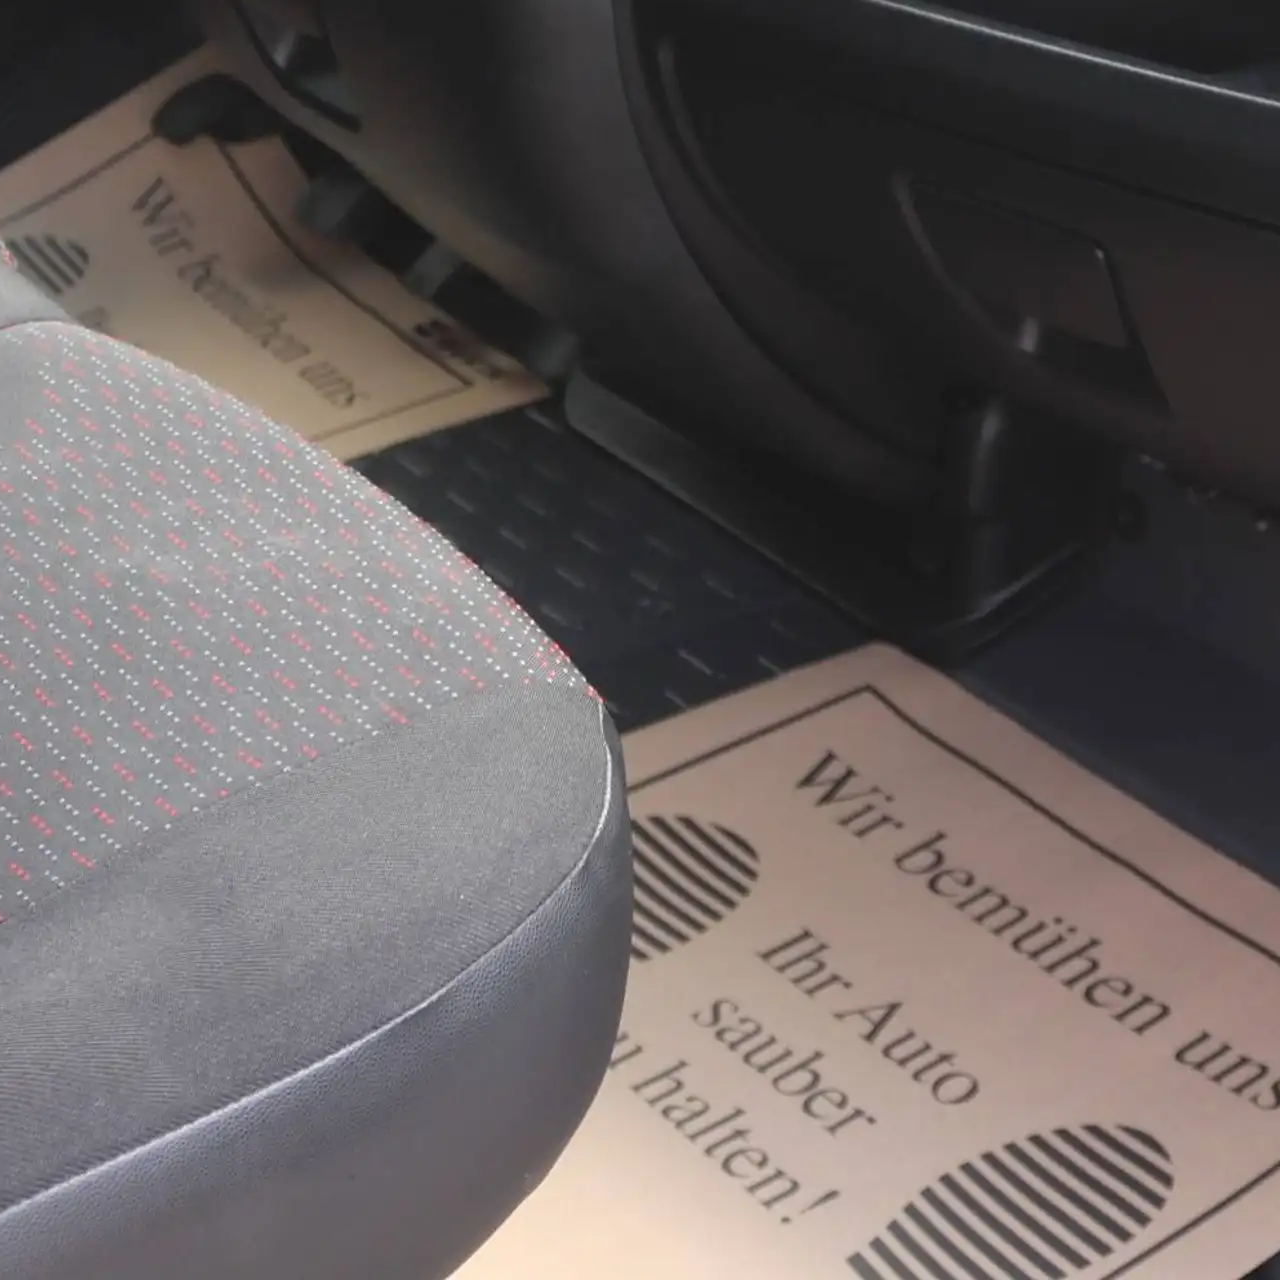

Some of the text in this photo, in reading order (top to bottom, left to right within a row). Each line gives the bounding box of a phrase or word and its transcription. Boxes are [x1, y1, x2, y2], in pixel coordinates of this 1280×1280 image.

[794, 748, 904, 839] Wir
[893, 830, 1173, 1036] bemühen
[691, 998, 878, 1138] sauber
[754, 927, 980, 1106] Ihr Auto
[630, 1059, 841, 1224] halten!
